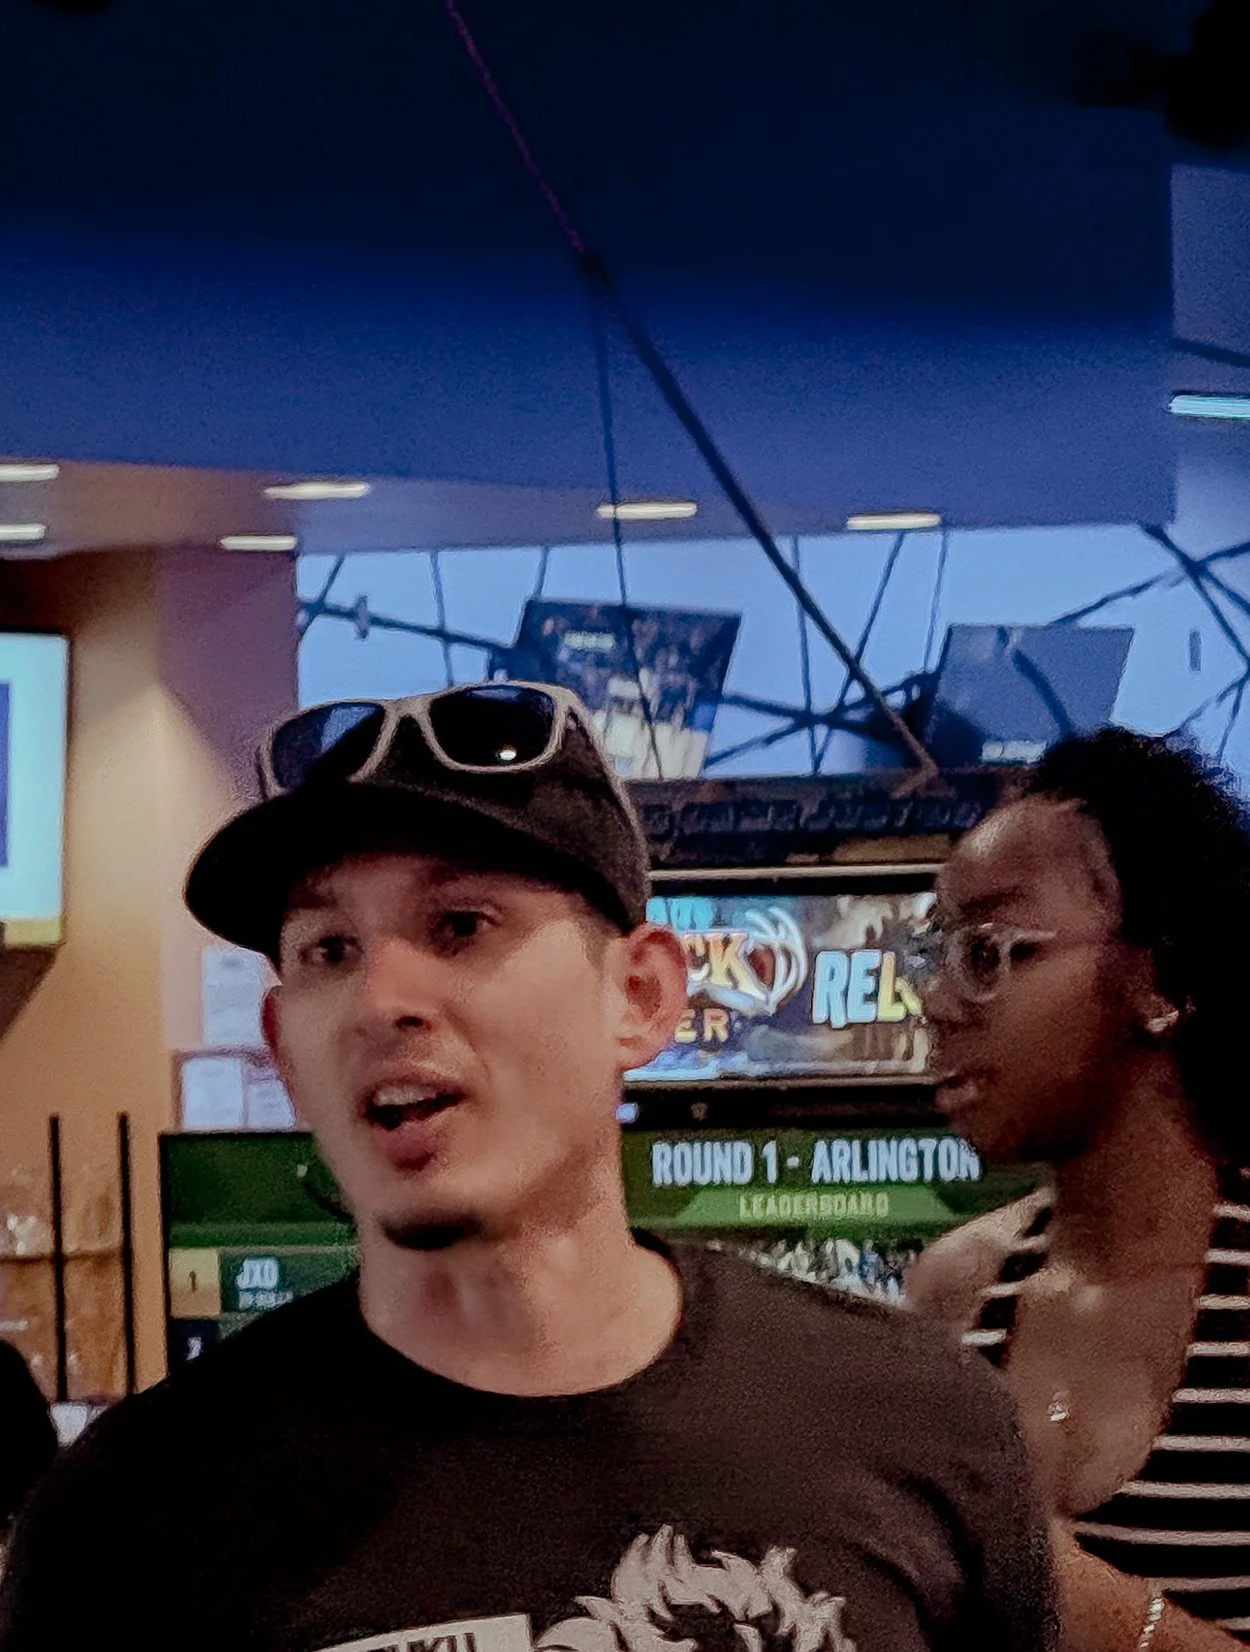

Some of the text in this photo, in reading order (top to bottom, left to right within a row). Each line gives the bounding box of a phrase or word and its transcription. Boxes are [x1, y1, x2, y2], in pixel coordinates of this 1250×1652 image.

[681, 933, 767, 1001] CK
[674, 1008, 729, 1043] ER
[652, 1140, 753, 1186] ROUND
[761, 1140, 778, 1184] 1
[811, 1137, 982, 1183] ARLINGTON
[739, 1192, 890, 1220] LEADERBOARD
